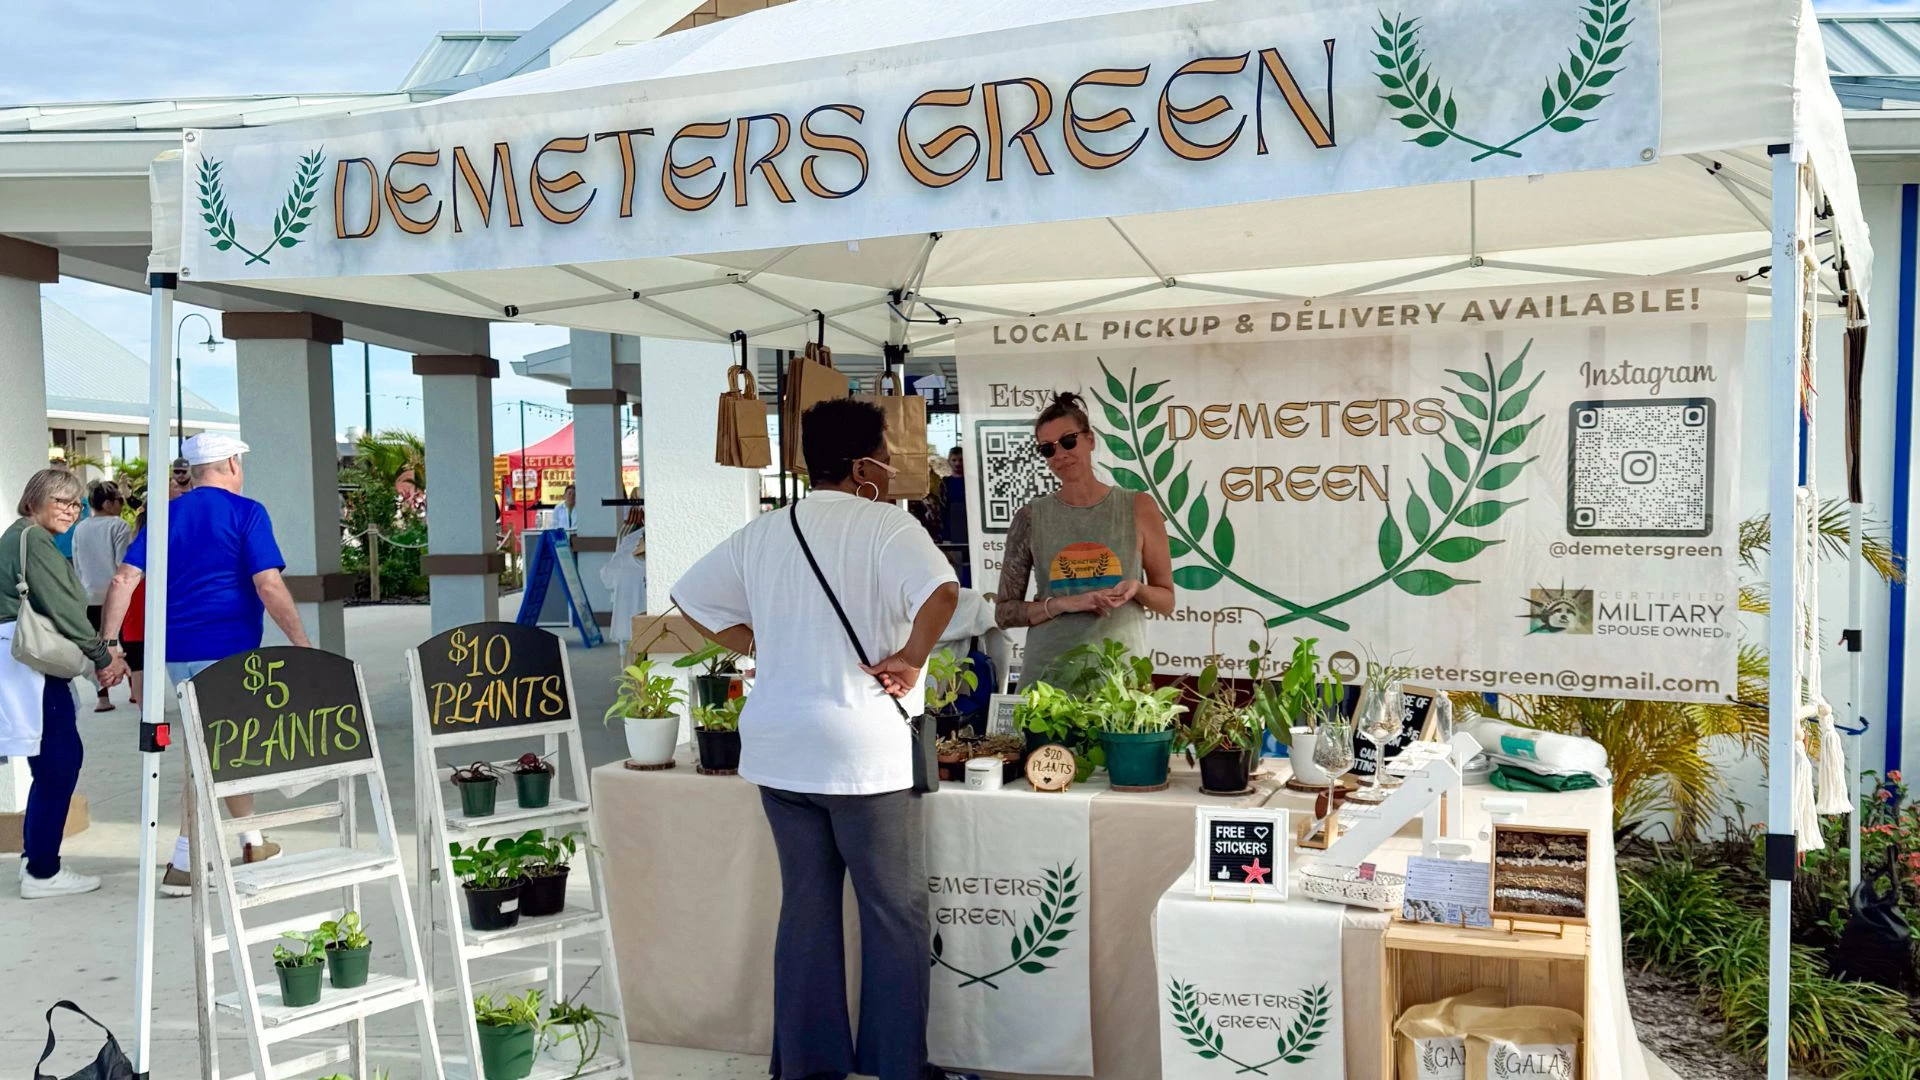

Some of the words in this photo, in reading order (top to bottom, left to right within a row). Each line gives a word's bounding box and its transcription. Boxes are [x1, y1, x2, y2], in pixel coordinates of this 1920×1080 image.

[332, 102, 871, 241] DEMETERS
[897, 38, 1337, 189] GREEN
[993, 322, 1089, 345] LOCAL
[1101, 315, 1222, 341] PICKUP
[1234, 313, 1255, 334] &
[1270, 302, 1447, 333] DELIVERY
[1460, 286, 1701, 323] AVAILABLE!
[1579, 359, 1718, 397] Instagram
[988, 383, 1051, 412] Etsy
[1167, 397, 1447, 441] DEMETERS
[1220, 464, 1391, 502] GREEN
[1550, 541, 1723, 560] @demetersgreen
[1598, 591, 1725, 602] CERTIFIED
[1144, 606, 1243, 628] orkshops!
[1598, 602, 1725, 623] MILITARY
[1598, 624, 1659, 636] SPOUSE
[447, 628, 512, 679] $10
[242, 653, 290, 709] $5
[430, 675, 564, 726] PLANTS
[207, 704, 362, 772] PLANTS
[1043, 747, 1063, 761] $20
[1032, 760, 1073, 775] PLANTS
[1215, 826, 1246, 839] FREE
[1214, 841, 1268, 856] STICKERS
[928, 876, 1042, 897] EMETERS
[936, 907, 1017, 927] GREEN
[1194, 991, 1302, 1010] DEMETERS
[1217, 1015, 1281, 1031] GREEN
[1434, 1045, 1467, 1069] GAI
[1505, 1052, 1561, 1075] GAIA
